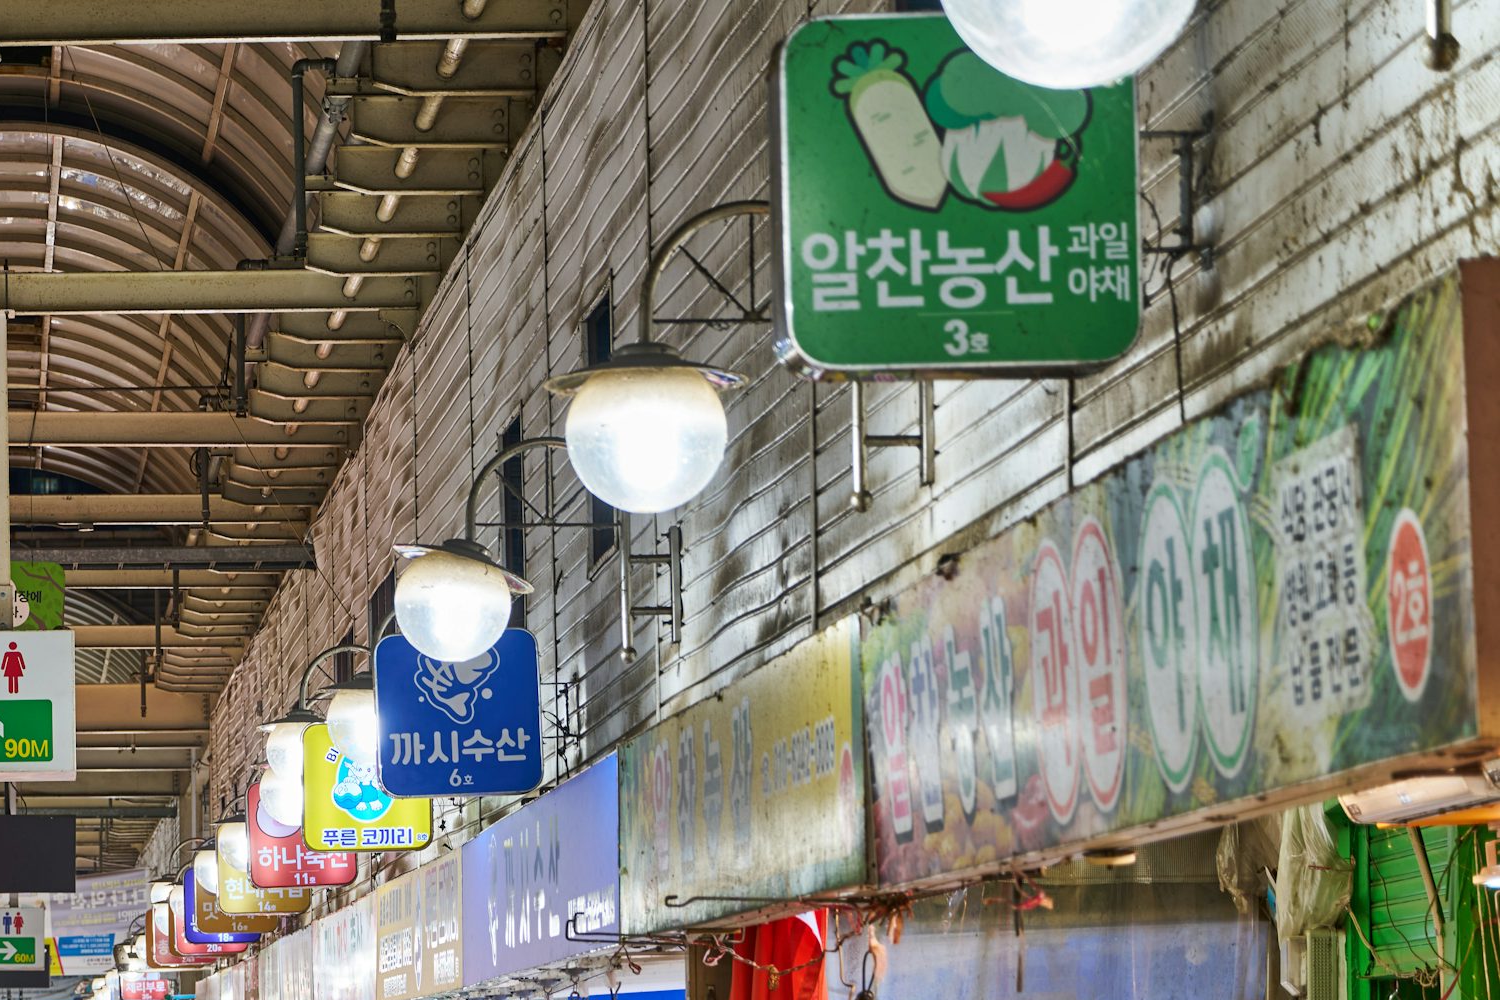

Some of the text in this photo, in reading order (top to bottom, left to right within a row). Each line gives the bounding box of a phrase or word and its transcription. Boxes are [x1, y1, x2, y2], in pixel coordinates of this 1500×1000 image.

[1068, 222, 1130, 260] 과일
[802, 226, 1059, 311] 알찬농산
[1068, 265, 1131, 302] 야채
[943, 319, 989, 356] 3호
[1147, 507, 1245, 728] 야채
[1036, 565, 1118, 762] 과일
[880, 596, 1018, 841] 알찬농산
[5, 739, 48, 758] 90M
[389, 728, 530, 765] 까시수산
[449, 769, 474, 787] 6호
[322, 828, 357, 847] 푸른
[362, 828, 412, 846] 코끼리
[294, 873, 316, 884] 11호
[258, 902, 276, 912] 14호
[15, 954, 35, 963] 60M
